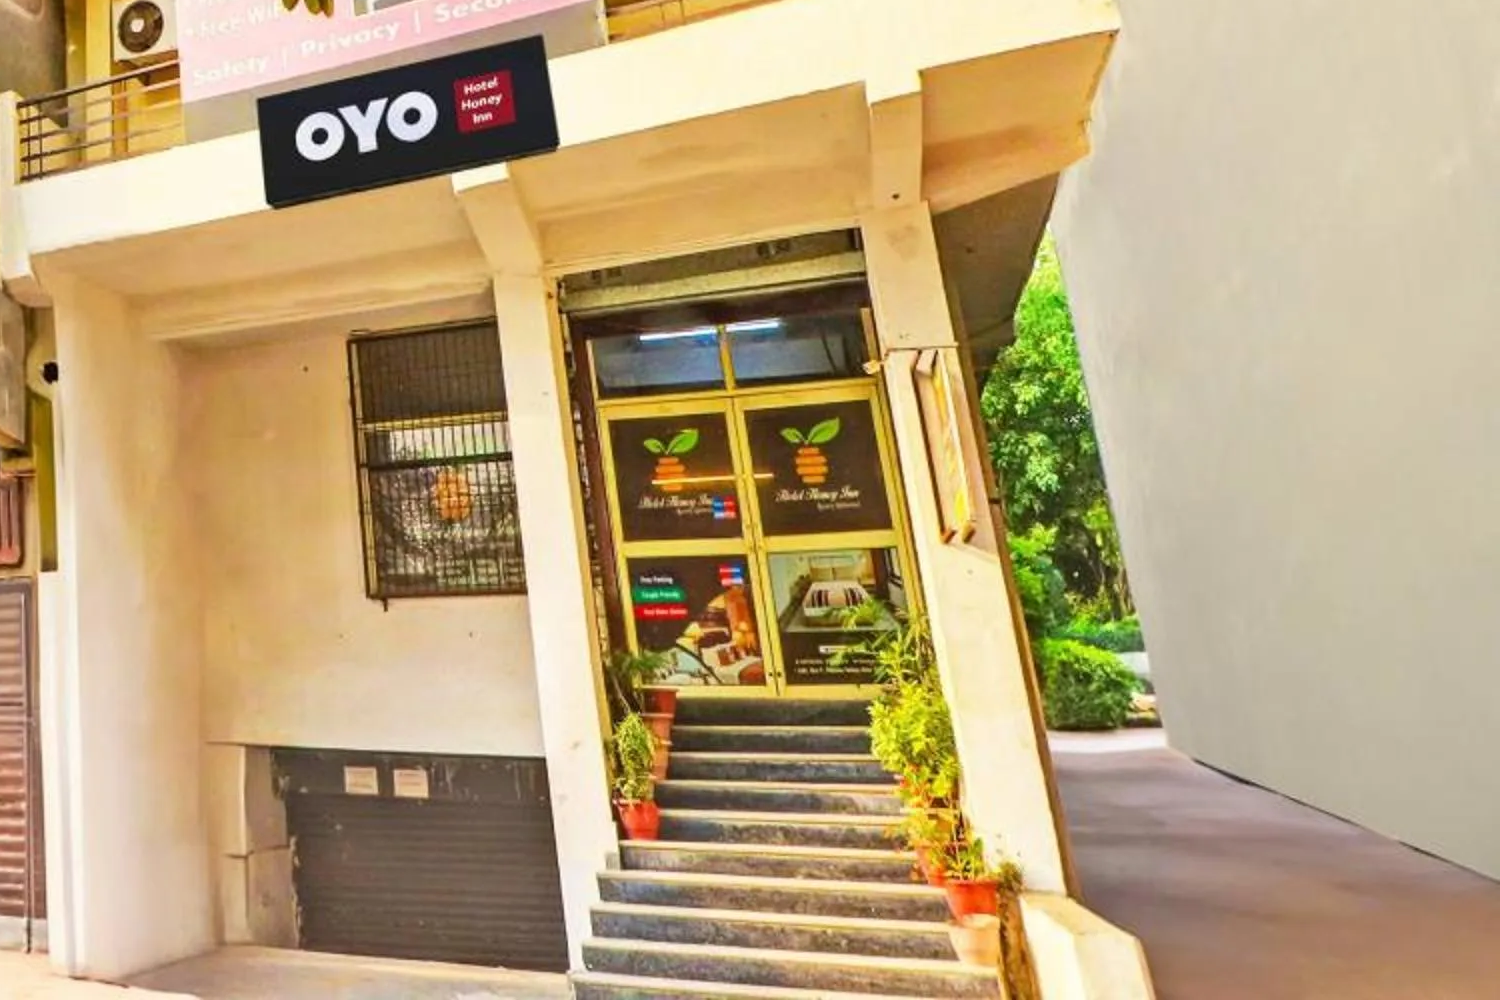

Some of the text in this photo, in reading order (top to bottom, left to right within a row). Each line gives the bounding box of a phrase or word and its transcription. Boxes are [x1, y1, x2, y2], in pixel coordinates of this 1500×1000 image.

[301, 20, 401, 56] Privacy
[464, 77, 499, 95] Hotel
[461, 94, 503, 111] Honey
[295, 91, 438, 161] OYO
[473, 112, 493, 124] Inn
